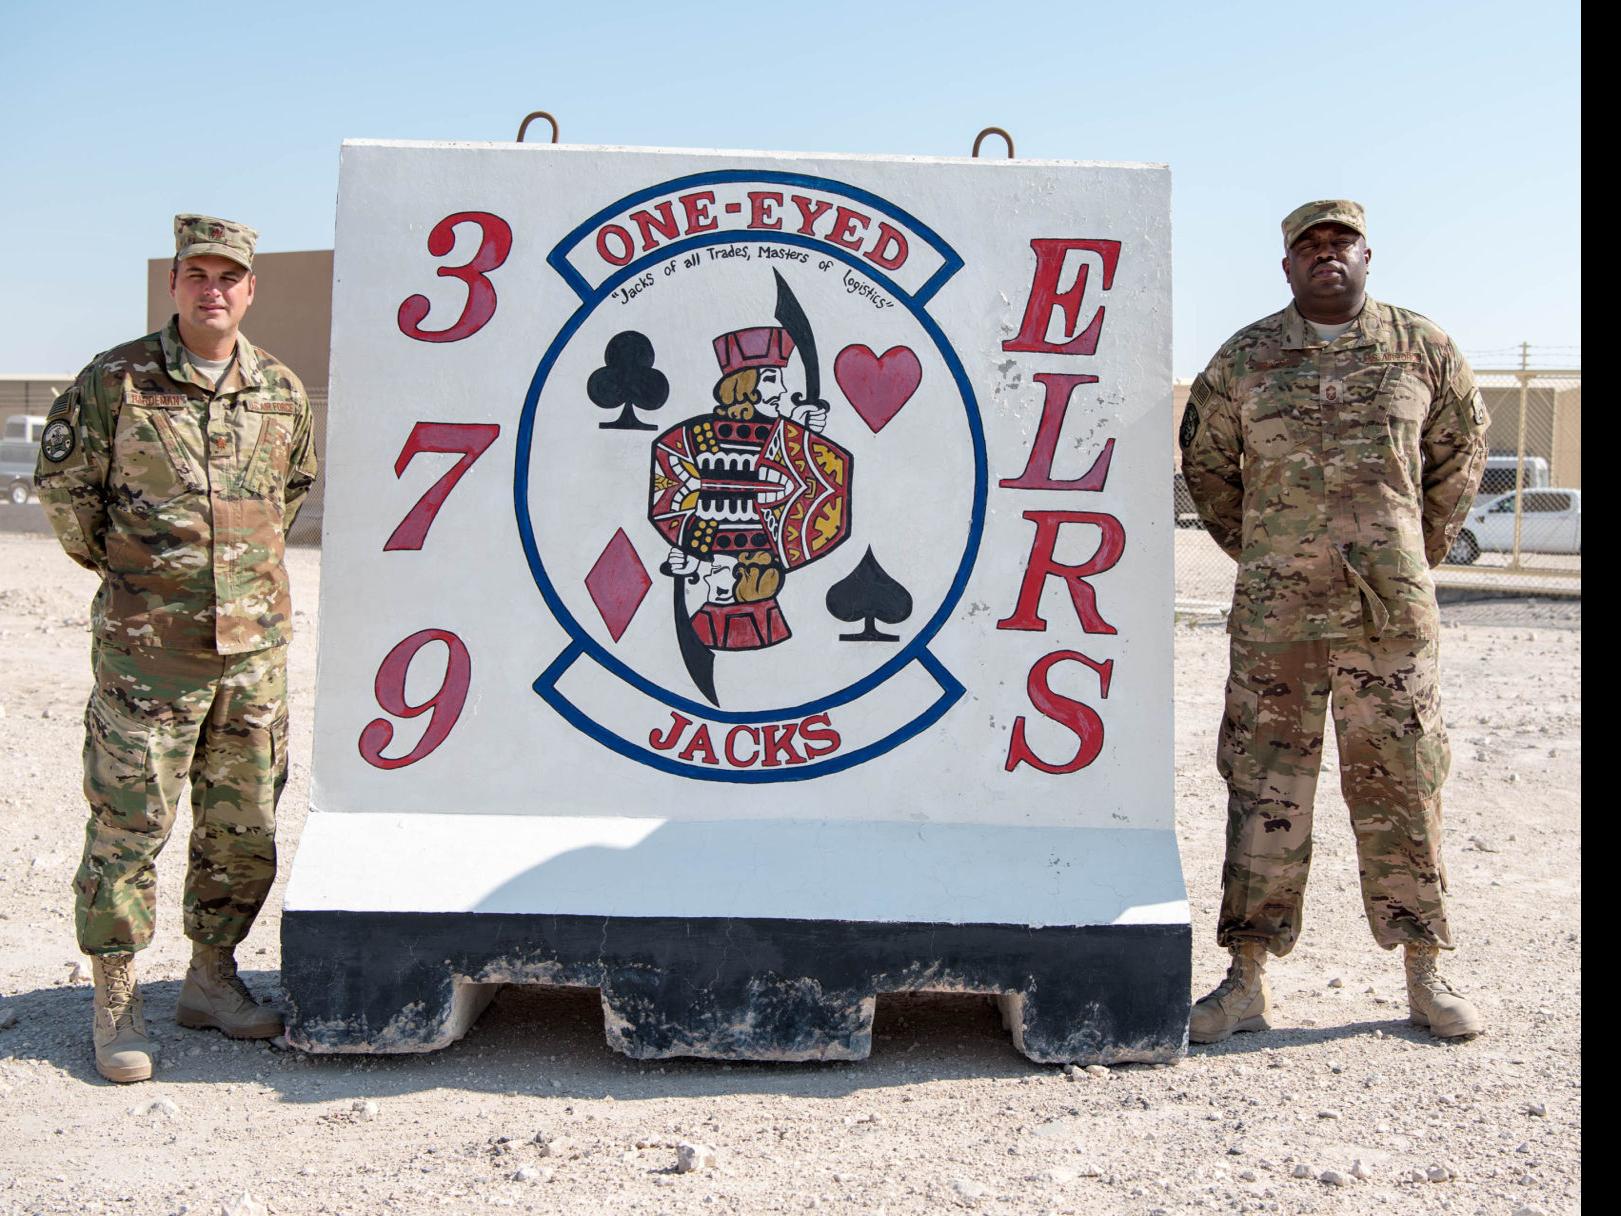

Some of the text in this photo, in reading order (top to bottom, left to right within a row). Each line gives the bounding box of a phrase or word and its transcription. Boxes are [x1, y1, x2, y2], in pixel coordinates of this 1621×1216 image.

[595, 190, 909, 271] ONE-EYED
[664, 260, 677, 276] of
[684, 252, 701, 269] all
[706, 244, 751, 261] Trades,
[757, 246, 810, 263] Masters
[818, 260, 834, 272] of
[648, 711, 842, 768] JACKS
